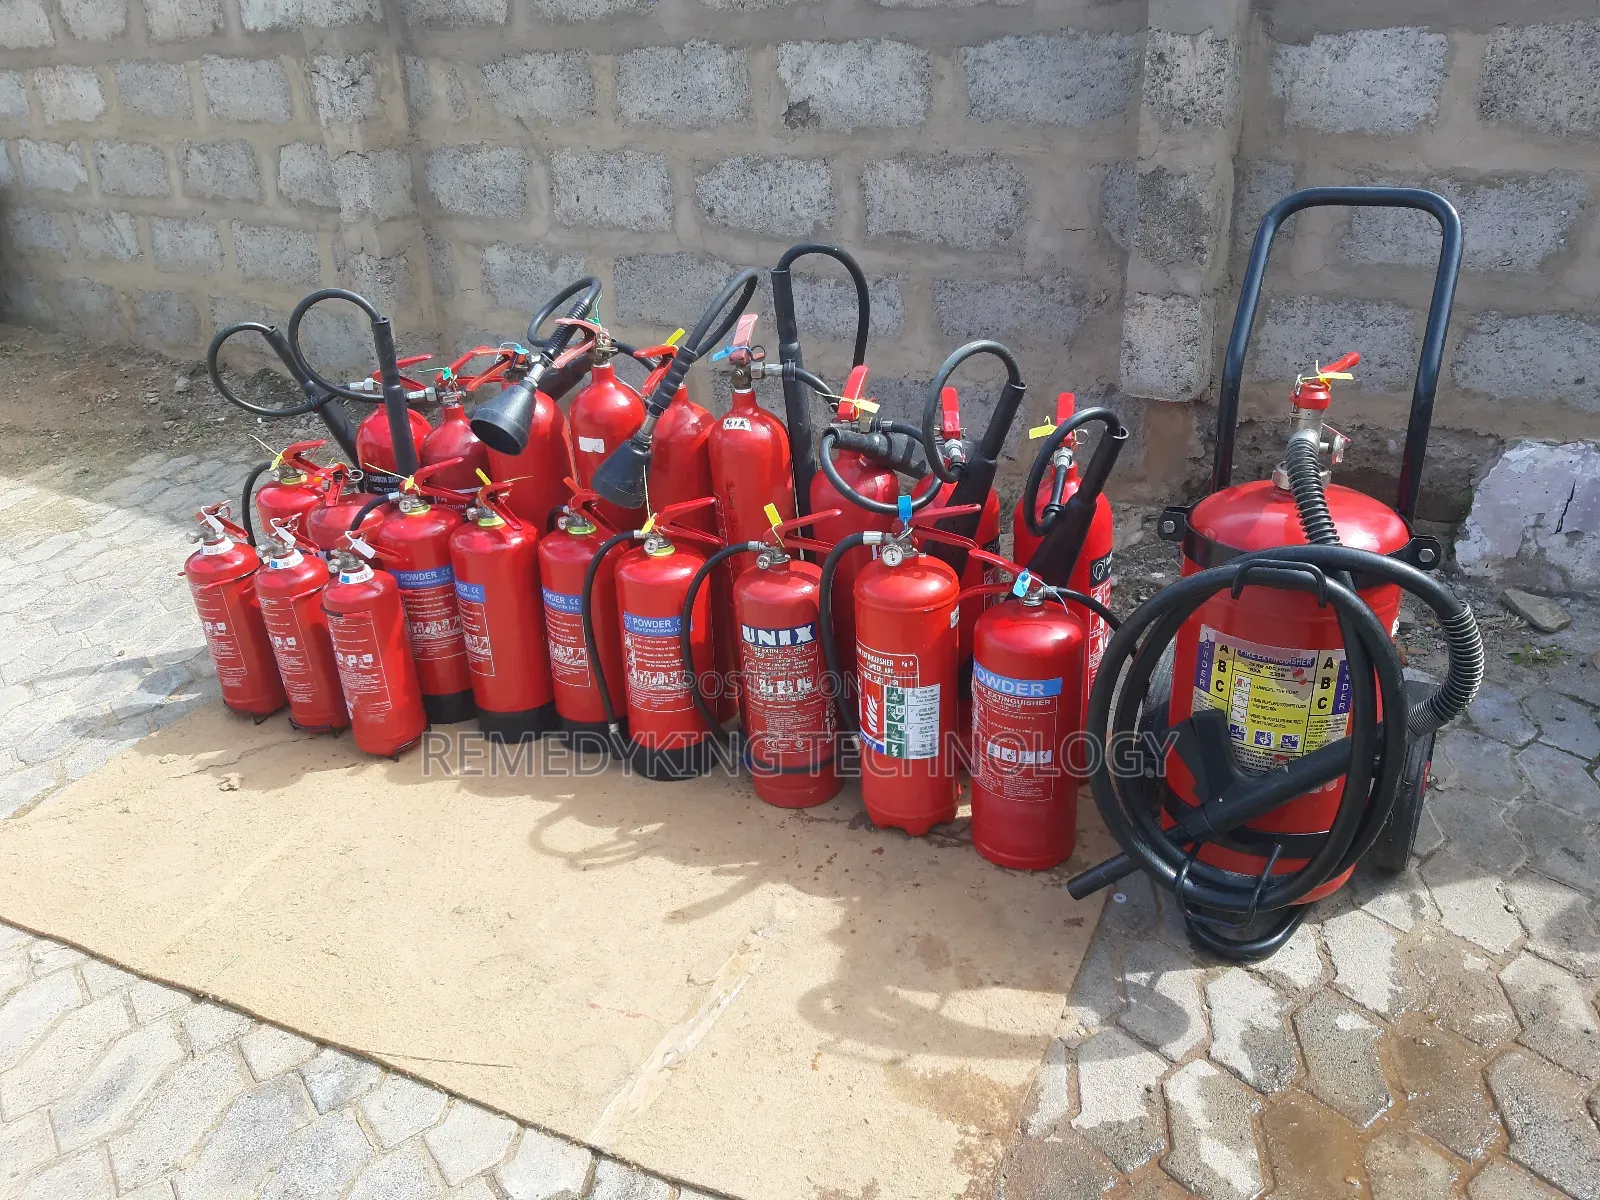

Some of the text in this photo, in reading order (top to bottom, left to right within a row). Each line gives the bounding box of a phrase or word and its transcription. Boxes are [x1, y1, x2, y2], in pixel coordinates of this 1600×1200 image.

[400, 571, 438, 581] POWDER
[632, 617, 672, 629] POWDER
[741, 624, 814, 646] UNIX
[1217, 659, 1227, 674] B
[1322, 656, 1334, 670] A
[1215, 679, 1225, 693] C
[1320, 676, 1331, 690] B
[987, 691, 1051, 706] EXTINGUISHER
[1317, 696, 1328, 710] C
